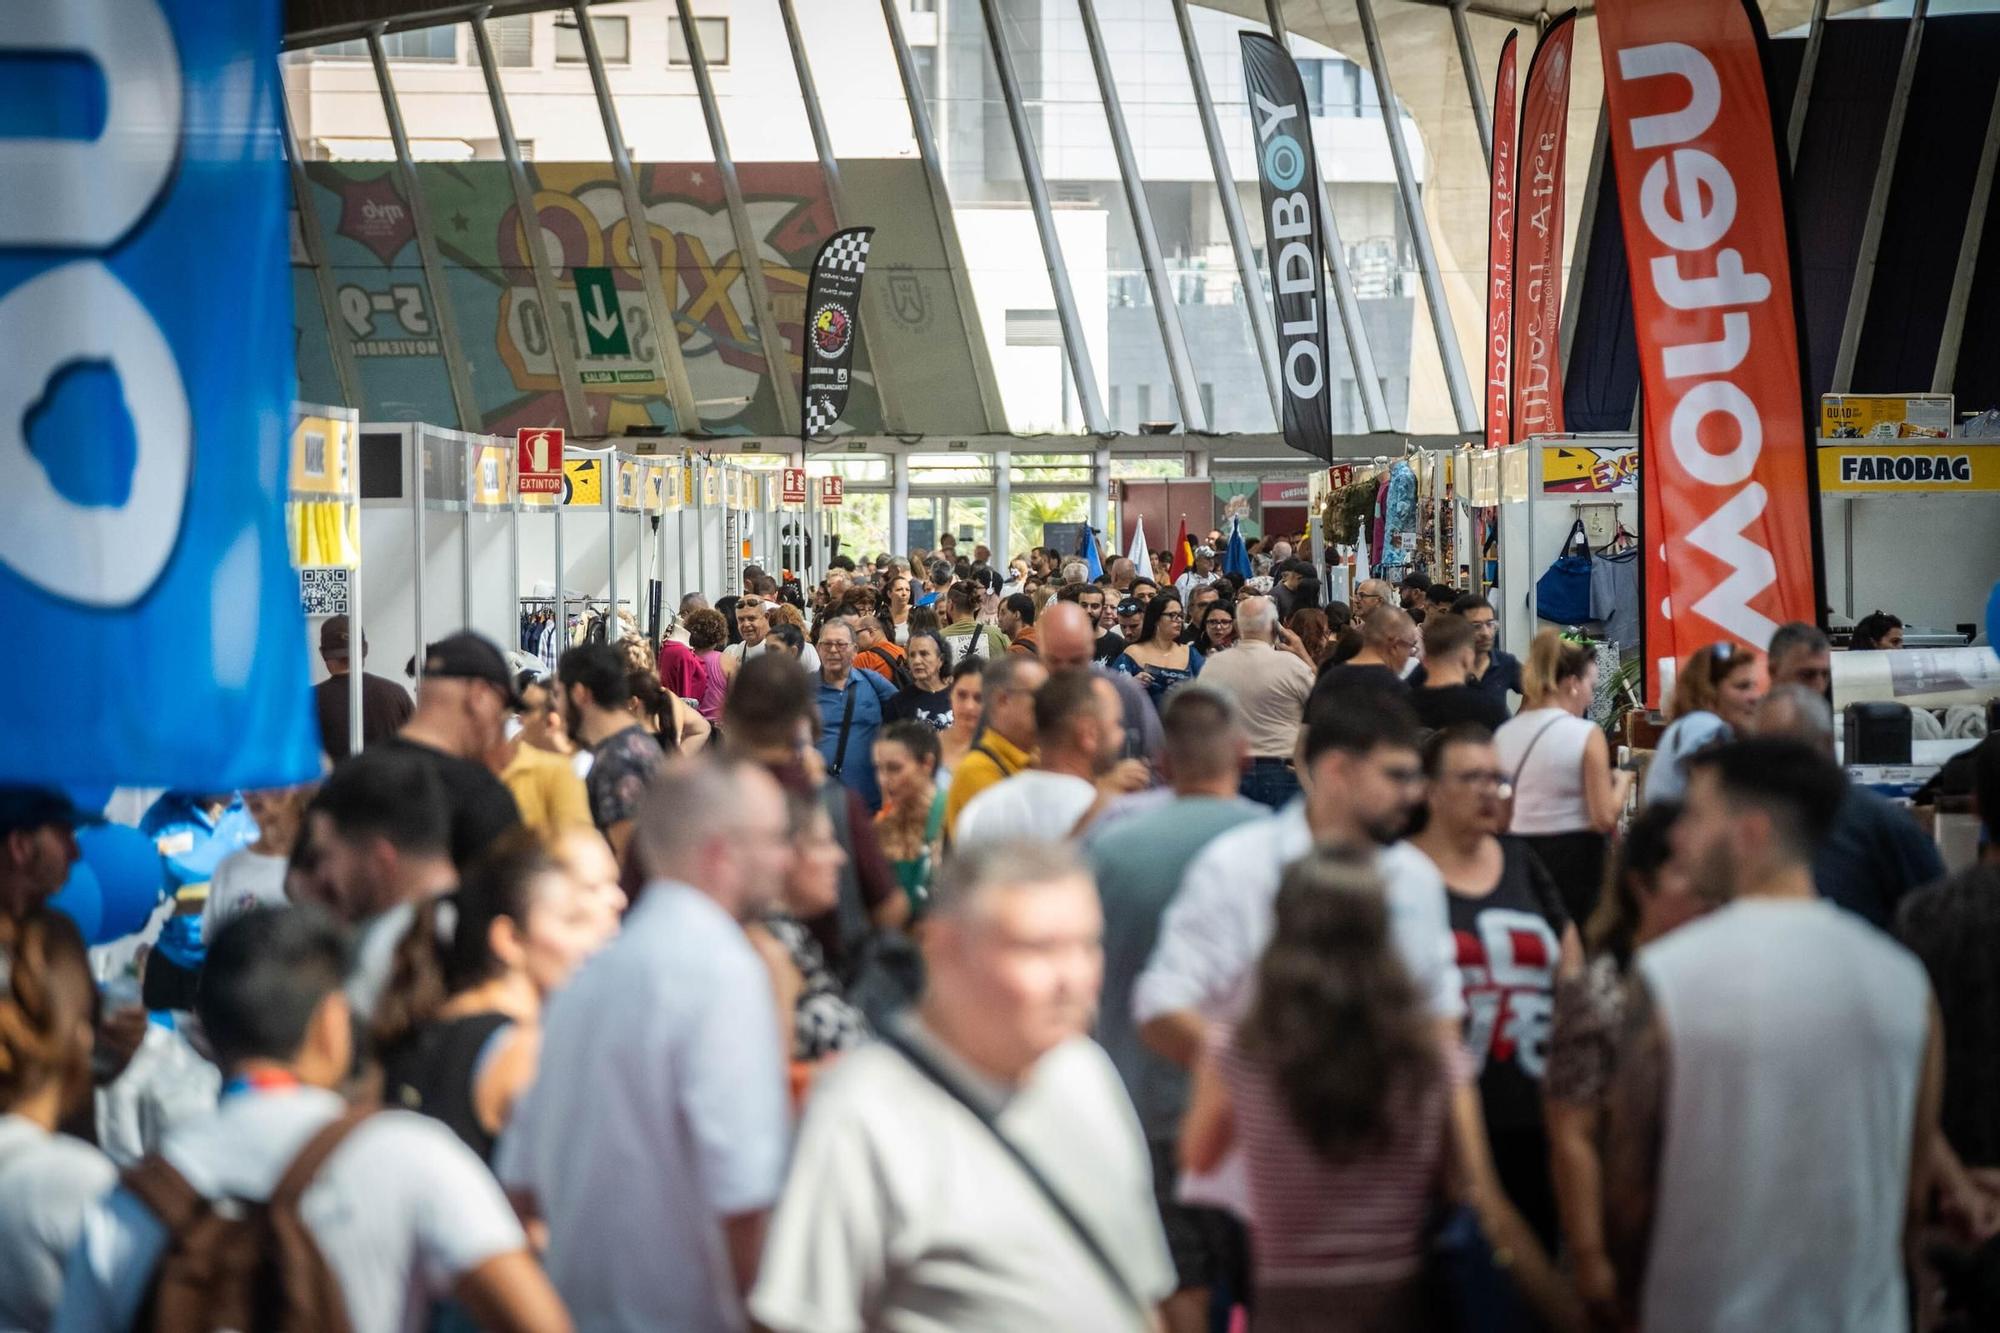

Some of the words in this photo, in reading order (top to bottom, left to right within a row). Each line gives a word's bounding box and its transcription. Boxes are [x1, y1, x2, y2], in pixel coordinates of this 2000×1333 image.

[1254, 92, 1323, 399] OLDBOY
[1826, 407, 1852, 418] QUAD
[1841, 456, 1970, 481] FAROBAG
[520, 478, 560, 489] EXTINTOR
